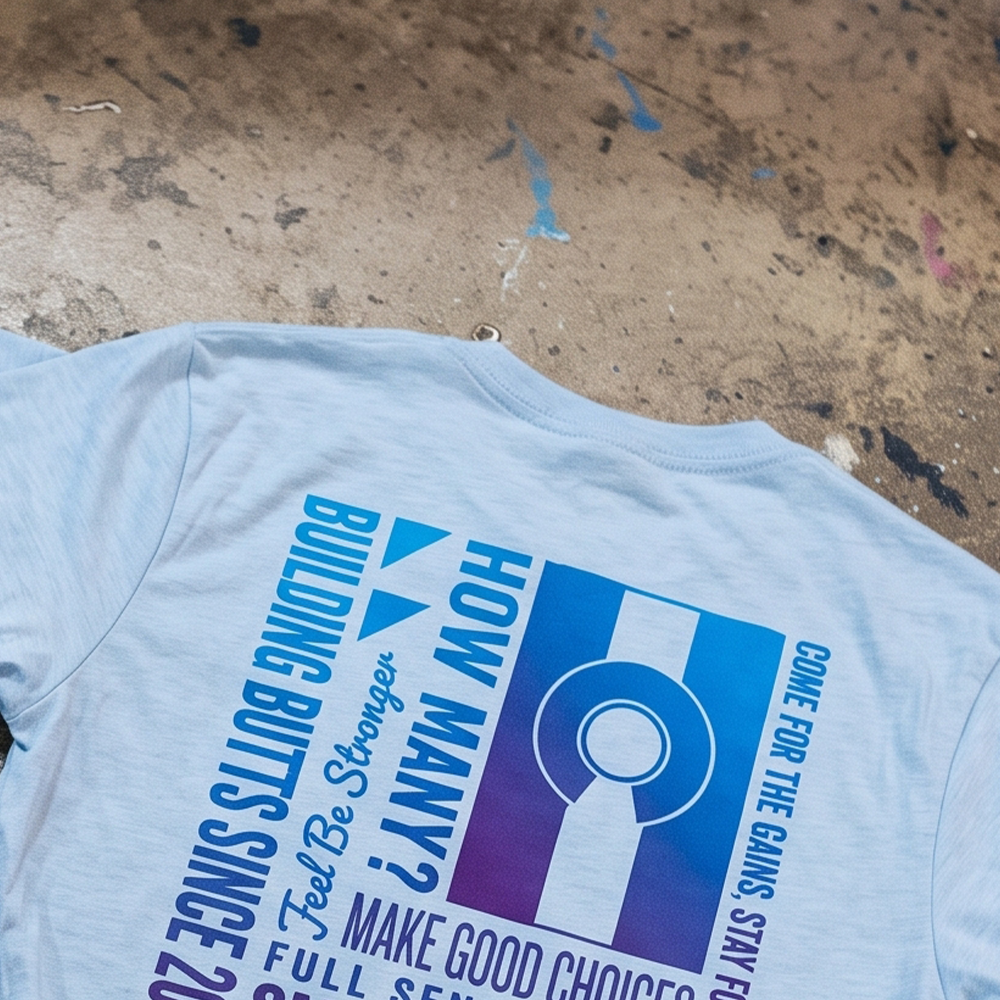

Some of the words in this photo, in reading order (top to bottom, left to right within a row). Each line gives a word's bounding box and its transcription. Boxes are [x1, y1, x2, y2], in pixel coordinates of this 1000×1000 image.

[252, 494, 381, 684] BUILDING
[433, 539, 534, 689] HOW
[782, 640, 831, 713] COME
[209, 678, 323, 822] BUTTS
[323, 651, 405, 798] Stronger
[769, 712, 814, 765] FOR
[303, 806, 354, 856] Be
[367, 692, 488, 894] MANY?
[756, 769, 801, 819] THE
[165, 819, 279, 960] SINCE
[278, 852, 336, 941] Feel
[730, 821, 788, 900] GAINS,
[263, 941, 366, 999] FULL
[341, 892, 447, 973] MAKE
[444, 922, 544, 999] GOOD
[719, 908, 767, 974] STAY
